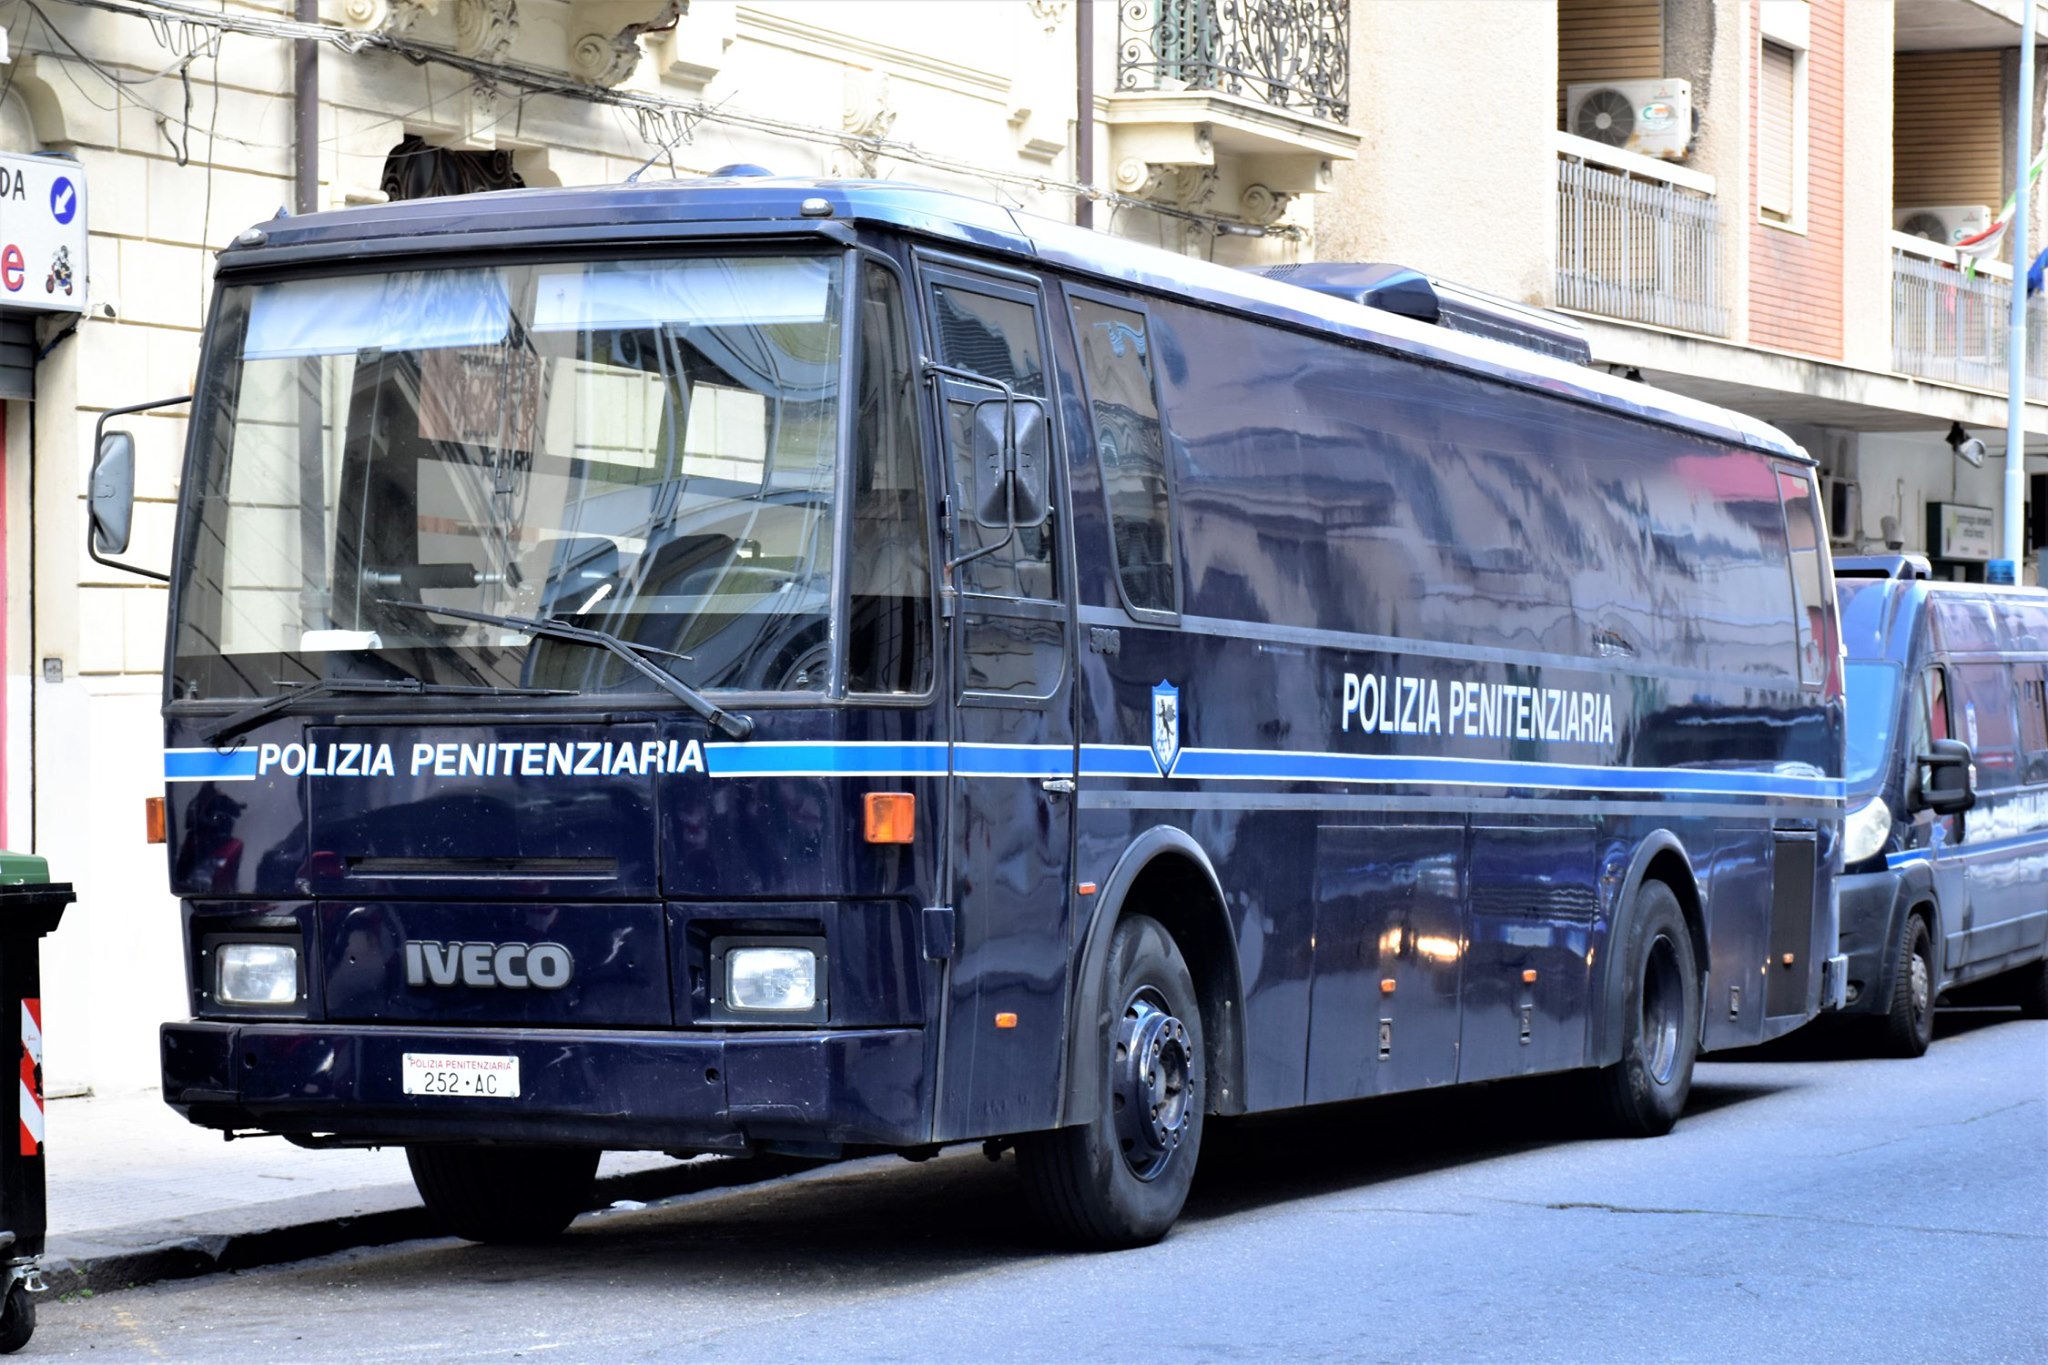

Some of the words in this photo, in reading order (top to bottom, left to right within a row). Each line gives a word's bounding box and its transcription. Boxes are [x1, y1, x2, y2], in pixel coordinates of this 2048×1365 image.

[1342, 672, 1441, 735] POLIZIA
[1448, 680, 1614, 745] PENITENZIARIA
[258, 743, 395, 776] POLIZIA
[410, 740, 704, 776] PENITENZIARIA
[405, 940, 574, 989] IVECO
[409, 1058, 443, 1068] POLIZIA
[445, 1060, 511, 1070] PENITENZIARIA
